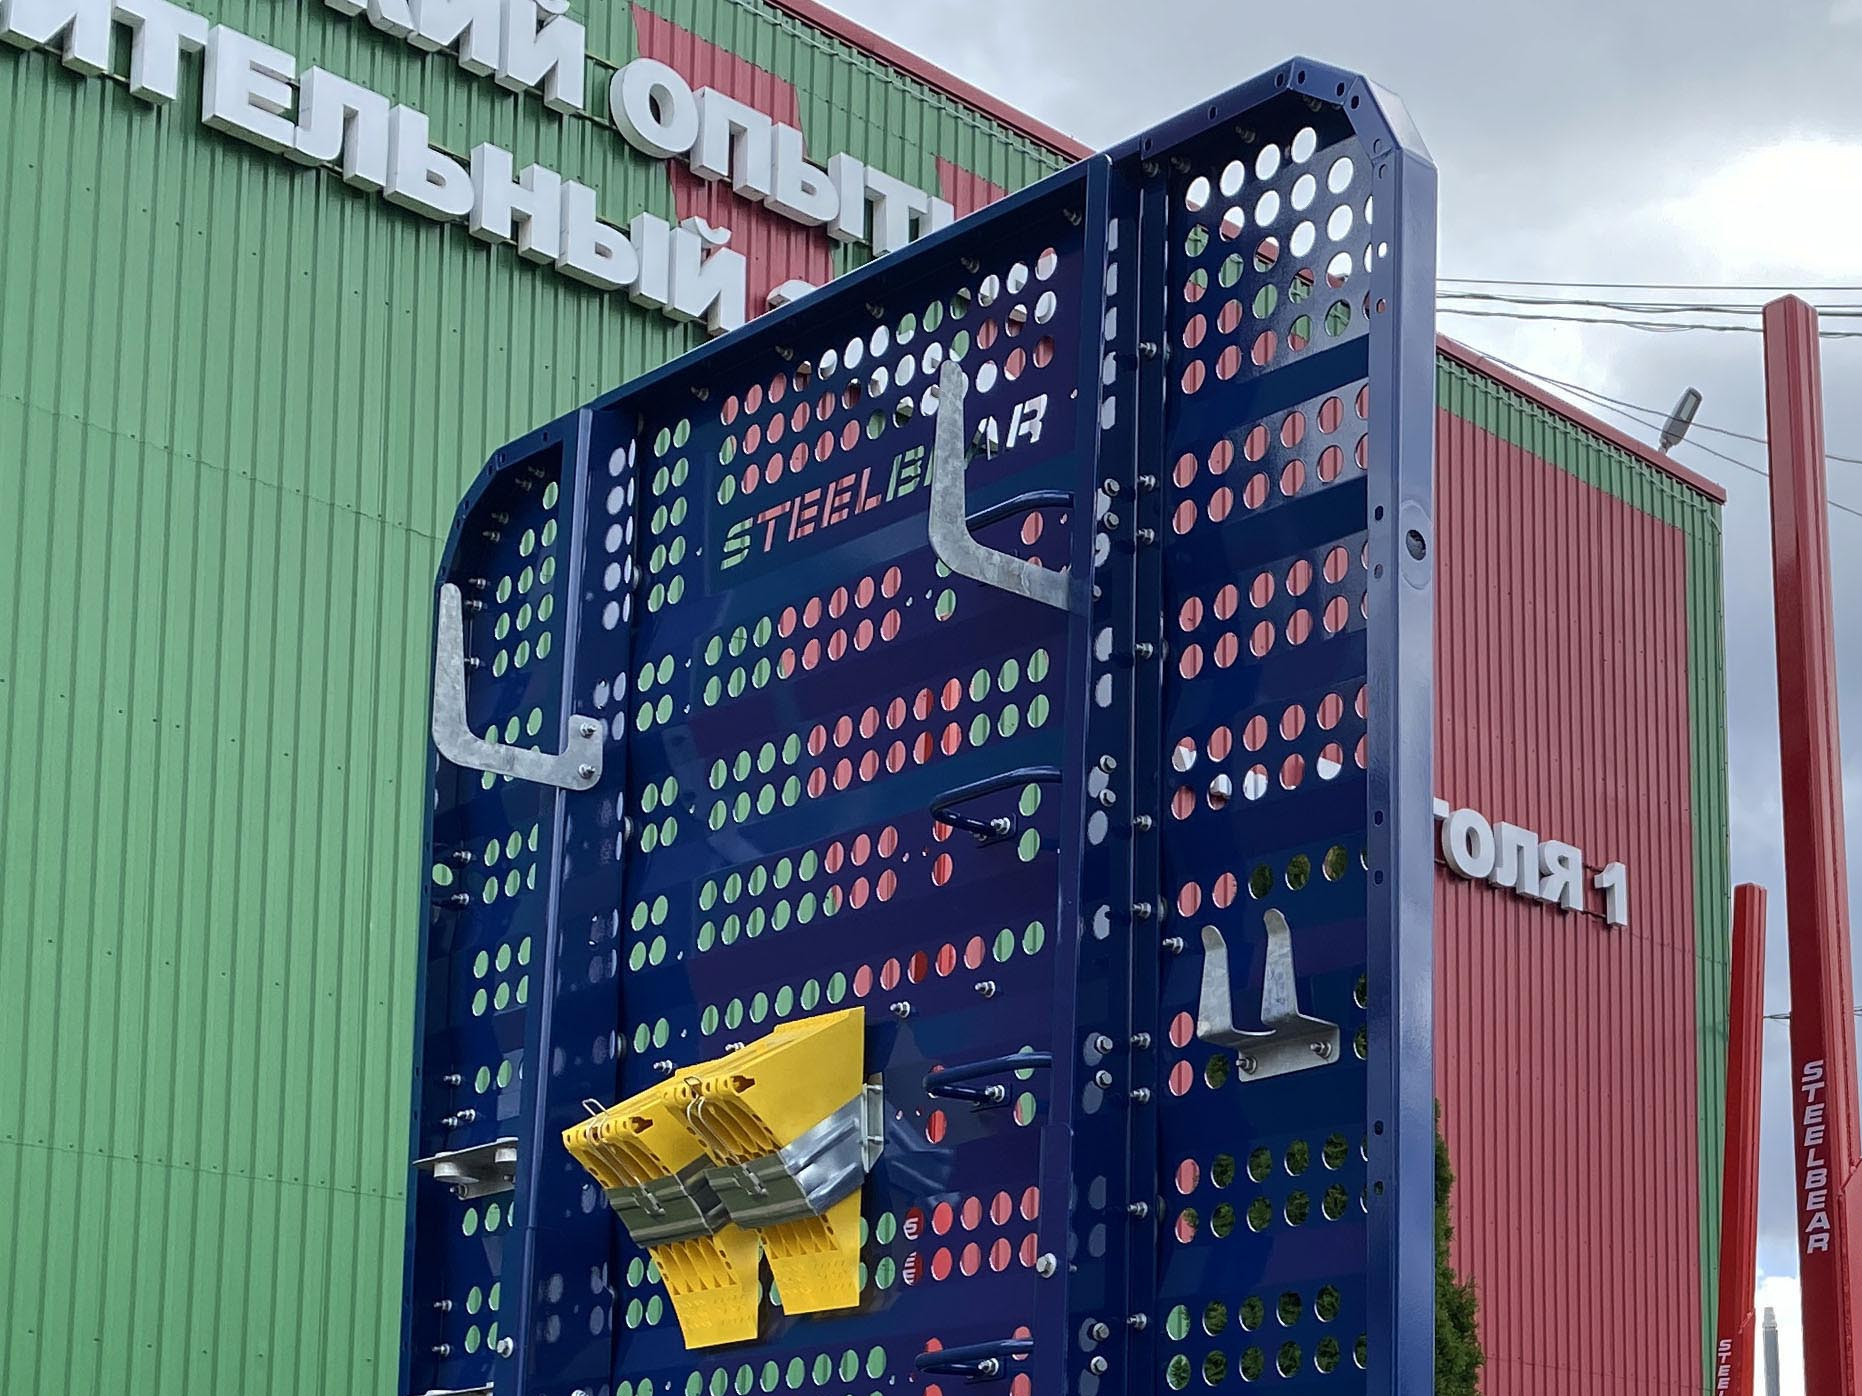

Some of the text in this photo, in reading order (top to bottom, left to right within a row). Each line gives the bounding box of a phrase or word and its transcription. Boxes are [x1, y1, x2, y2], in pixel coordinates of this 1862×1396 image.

[325, 0, 586, 114] ИЙ
[720, 393, 1048, 571] STEELBAR
[1433, 796, 1628, 928] ОЛЯ 1
[1802, 1059, 1830, 1255] STEELBEAR
